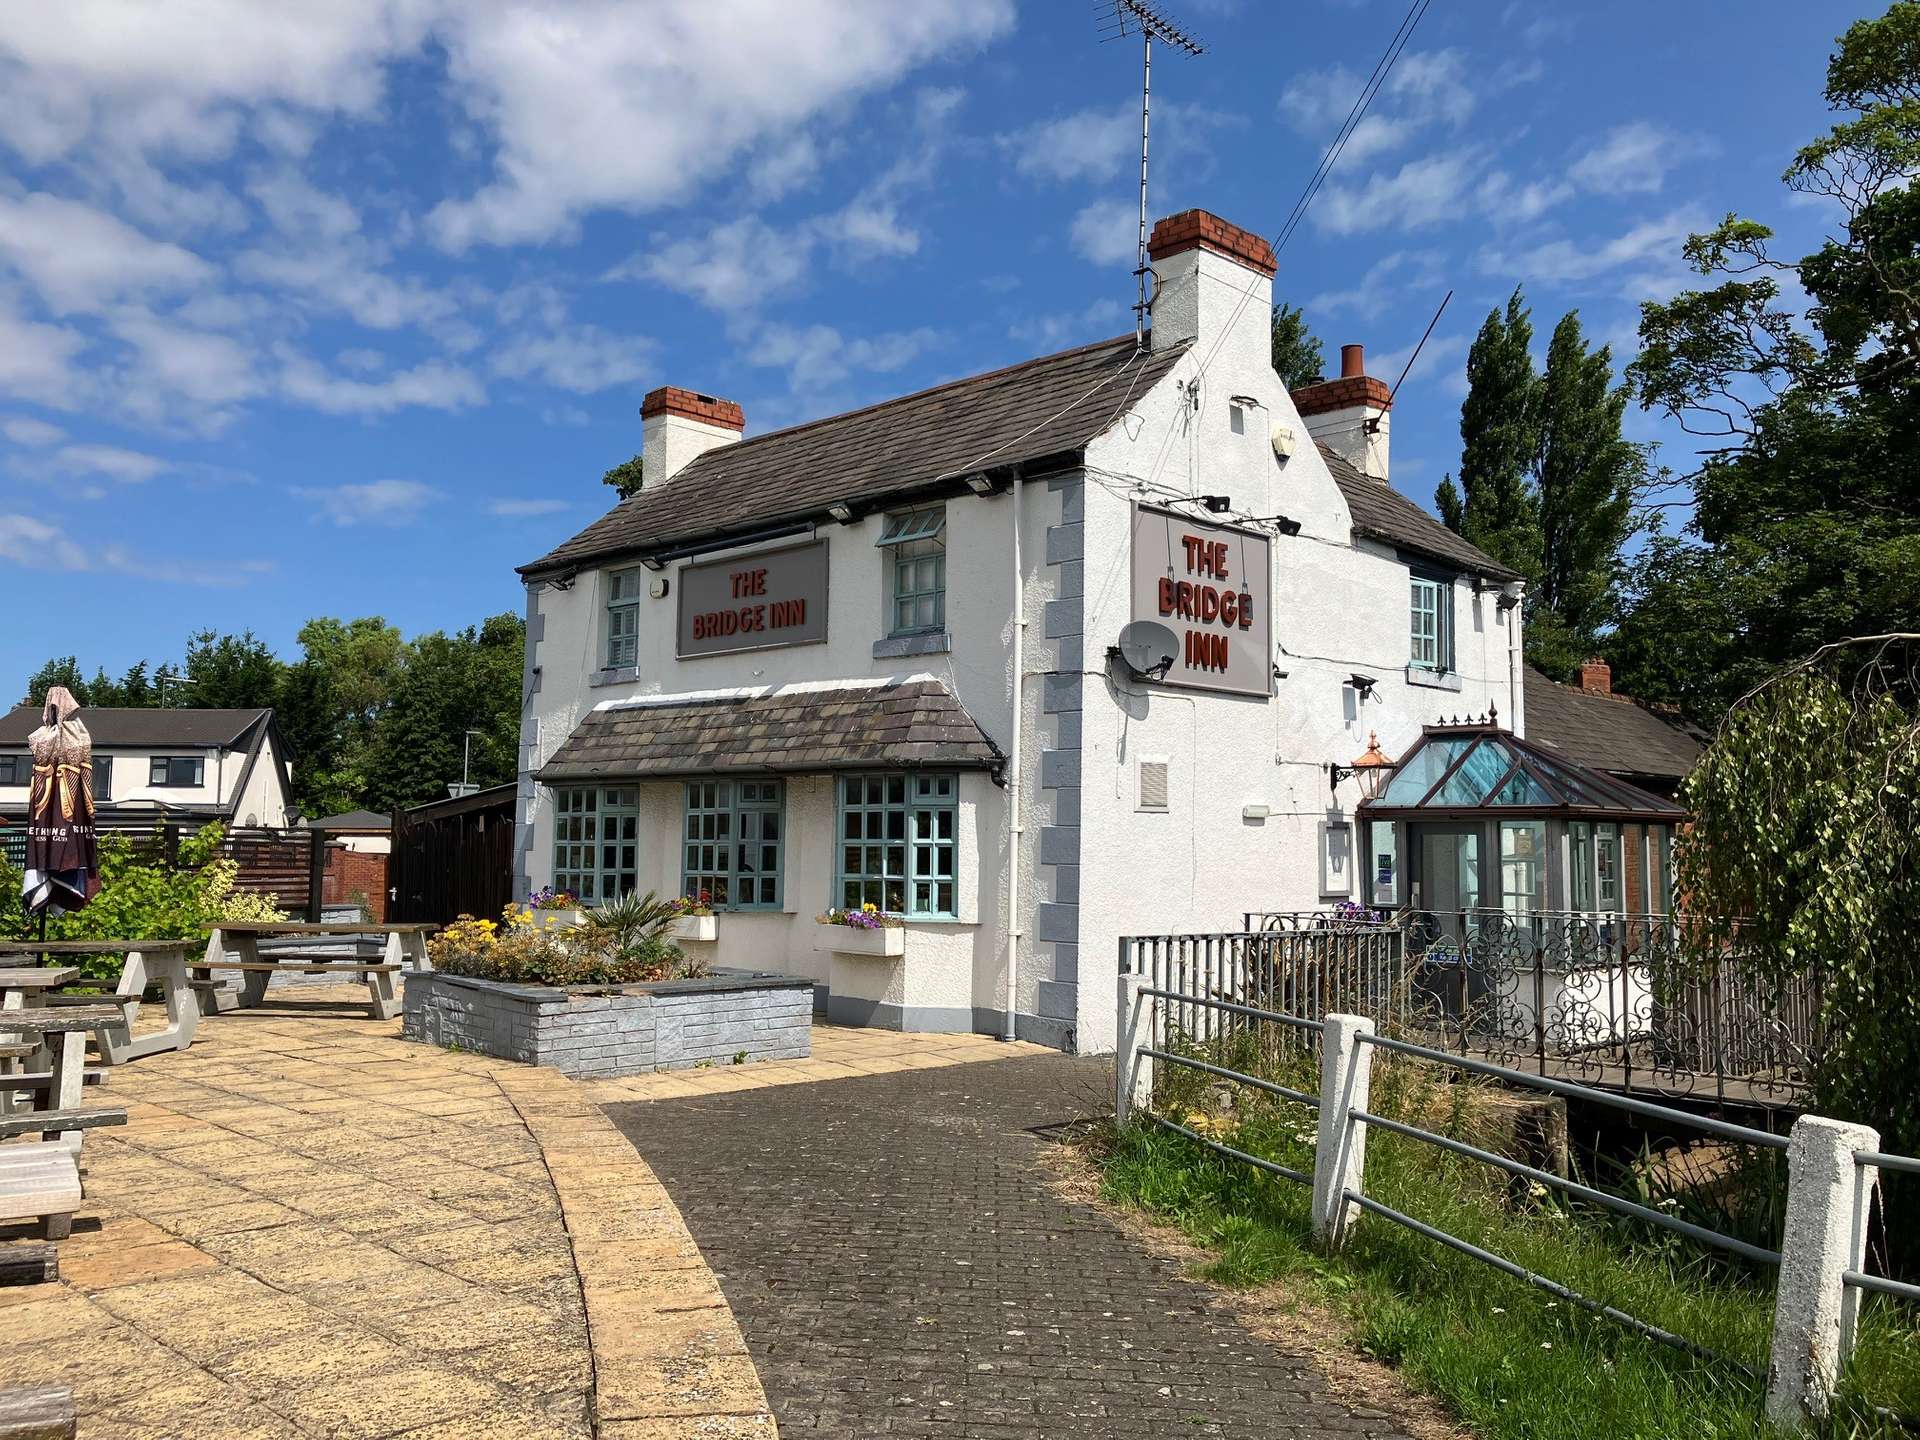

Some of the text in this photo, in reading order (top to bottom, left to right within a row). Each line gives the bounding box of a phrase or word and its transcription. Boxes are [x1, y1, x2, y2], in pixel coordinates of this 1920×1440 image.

[1182, 535, 1229, 579] THE
[730, 568, 768, 599] THE
[1158, 577, 1253, 630] BRIDGE
[693, 598, 807, 640] BRIDGE INN
[1185, 630, 1229, 672] INN
